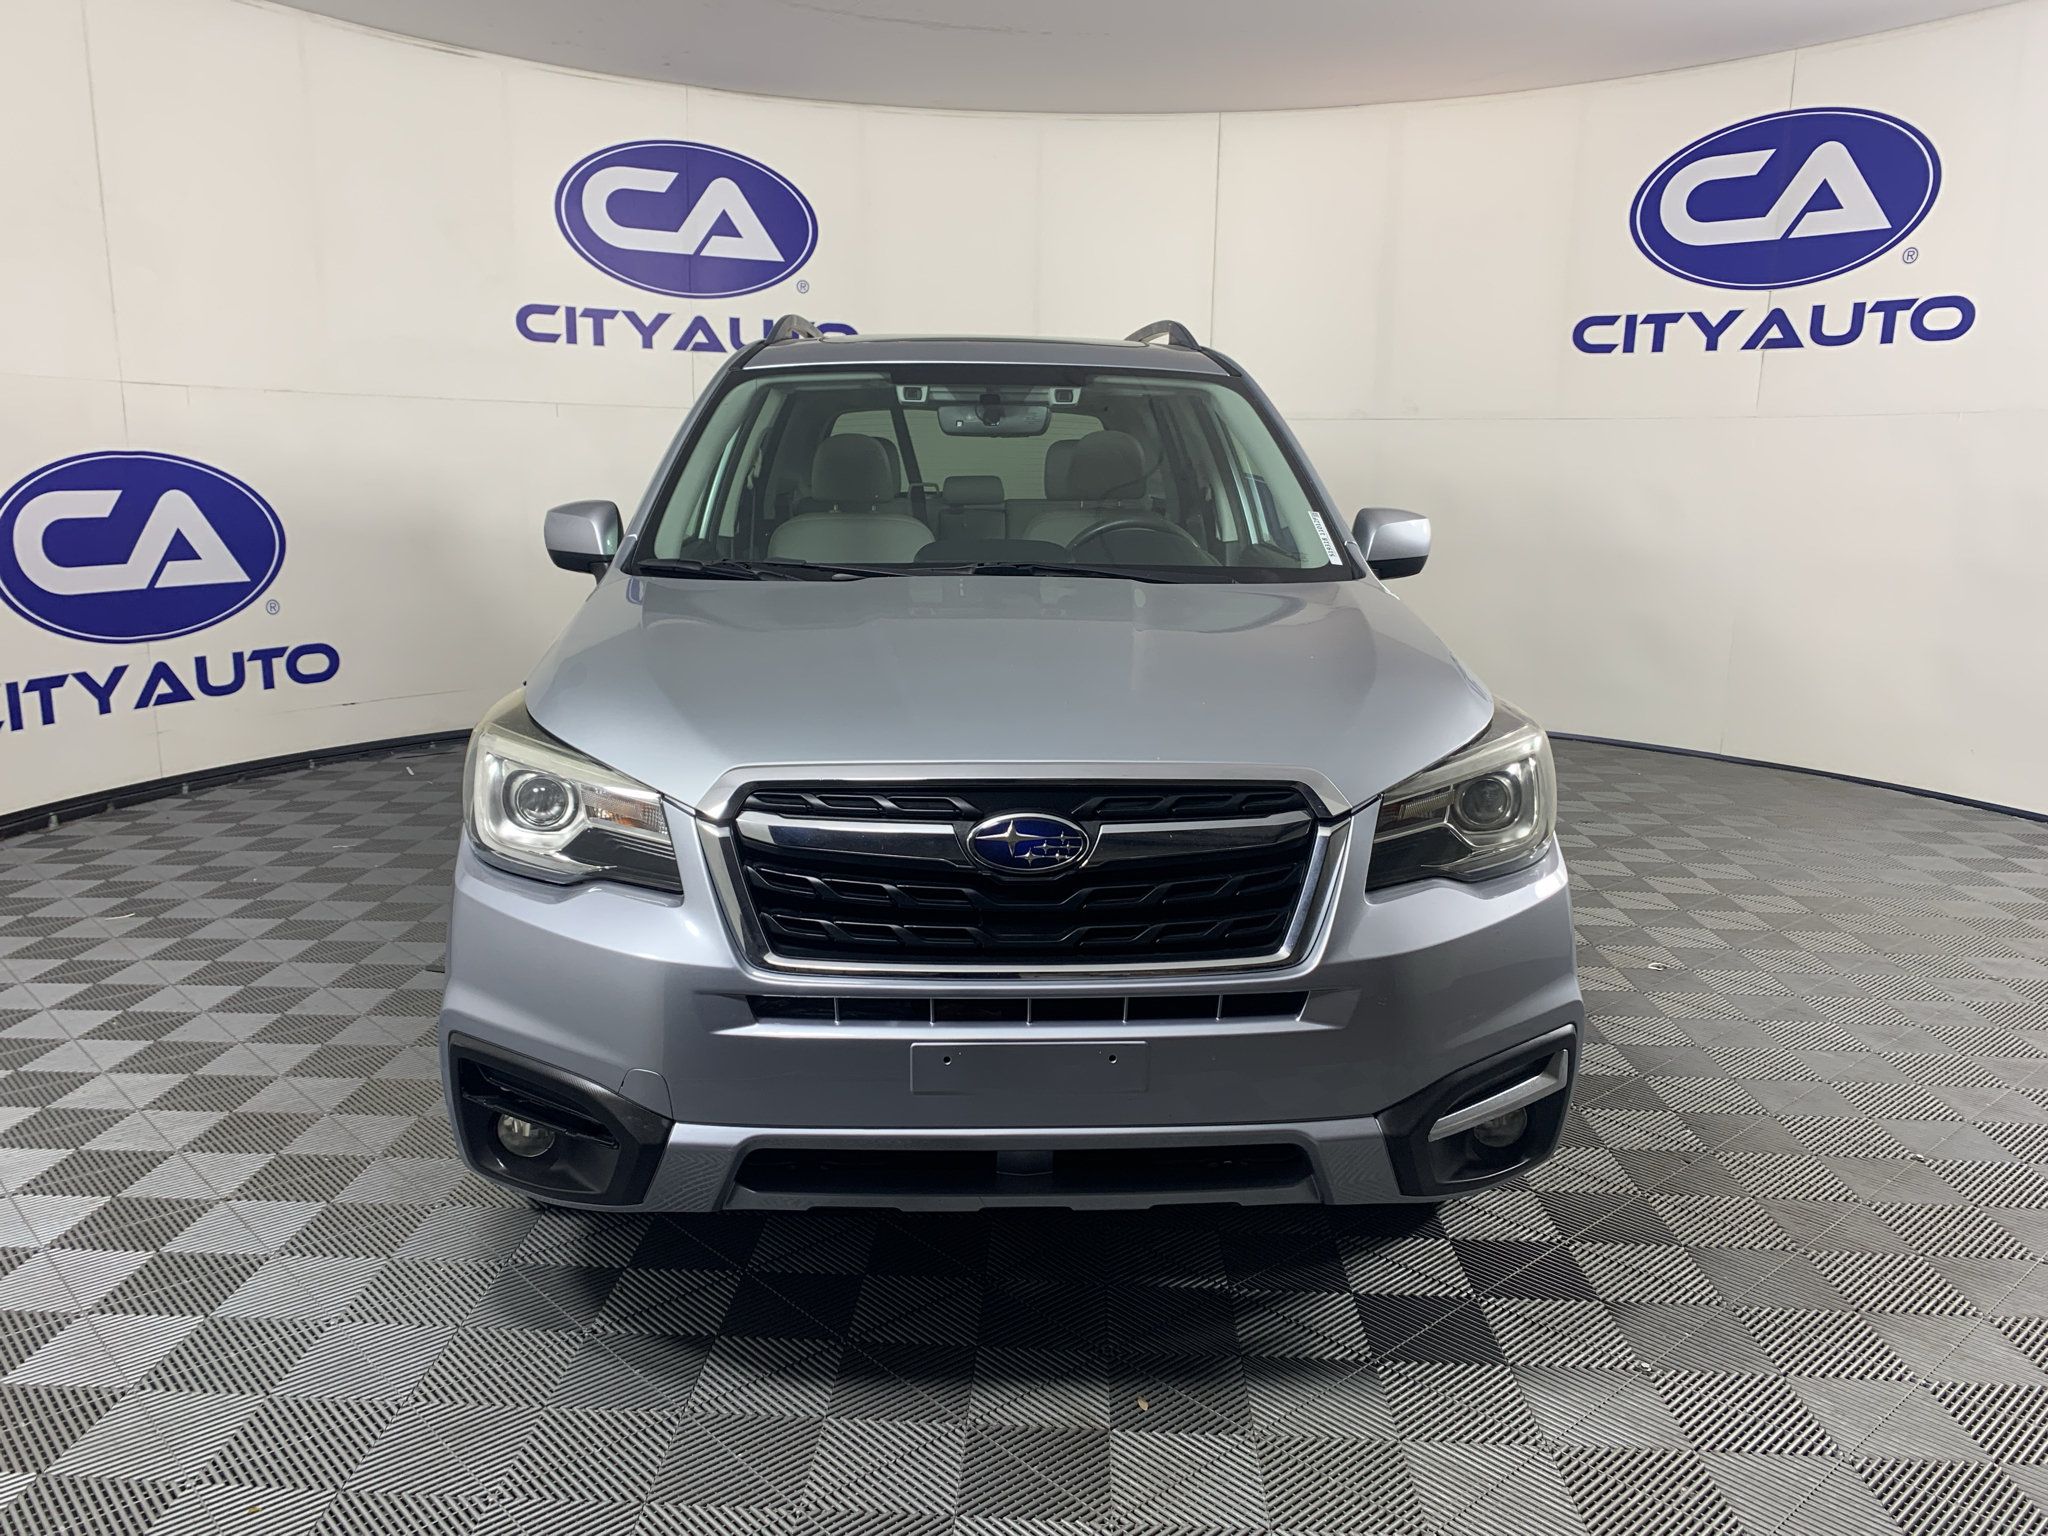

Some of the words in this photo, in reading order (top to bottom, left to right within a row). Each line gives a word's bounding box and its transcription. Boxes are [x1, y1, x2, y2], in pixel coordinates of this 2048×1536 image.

[582, 166, 786, 262] CA
[1660, 140, 1893, 246] CA
[13, 488, 251, 596] CA
[0, 664, 129, 732] ITY
